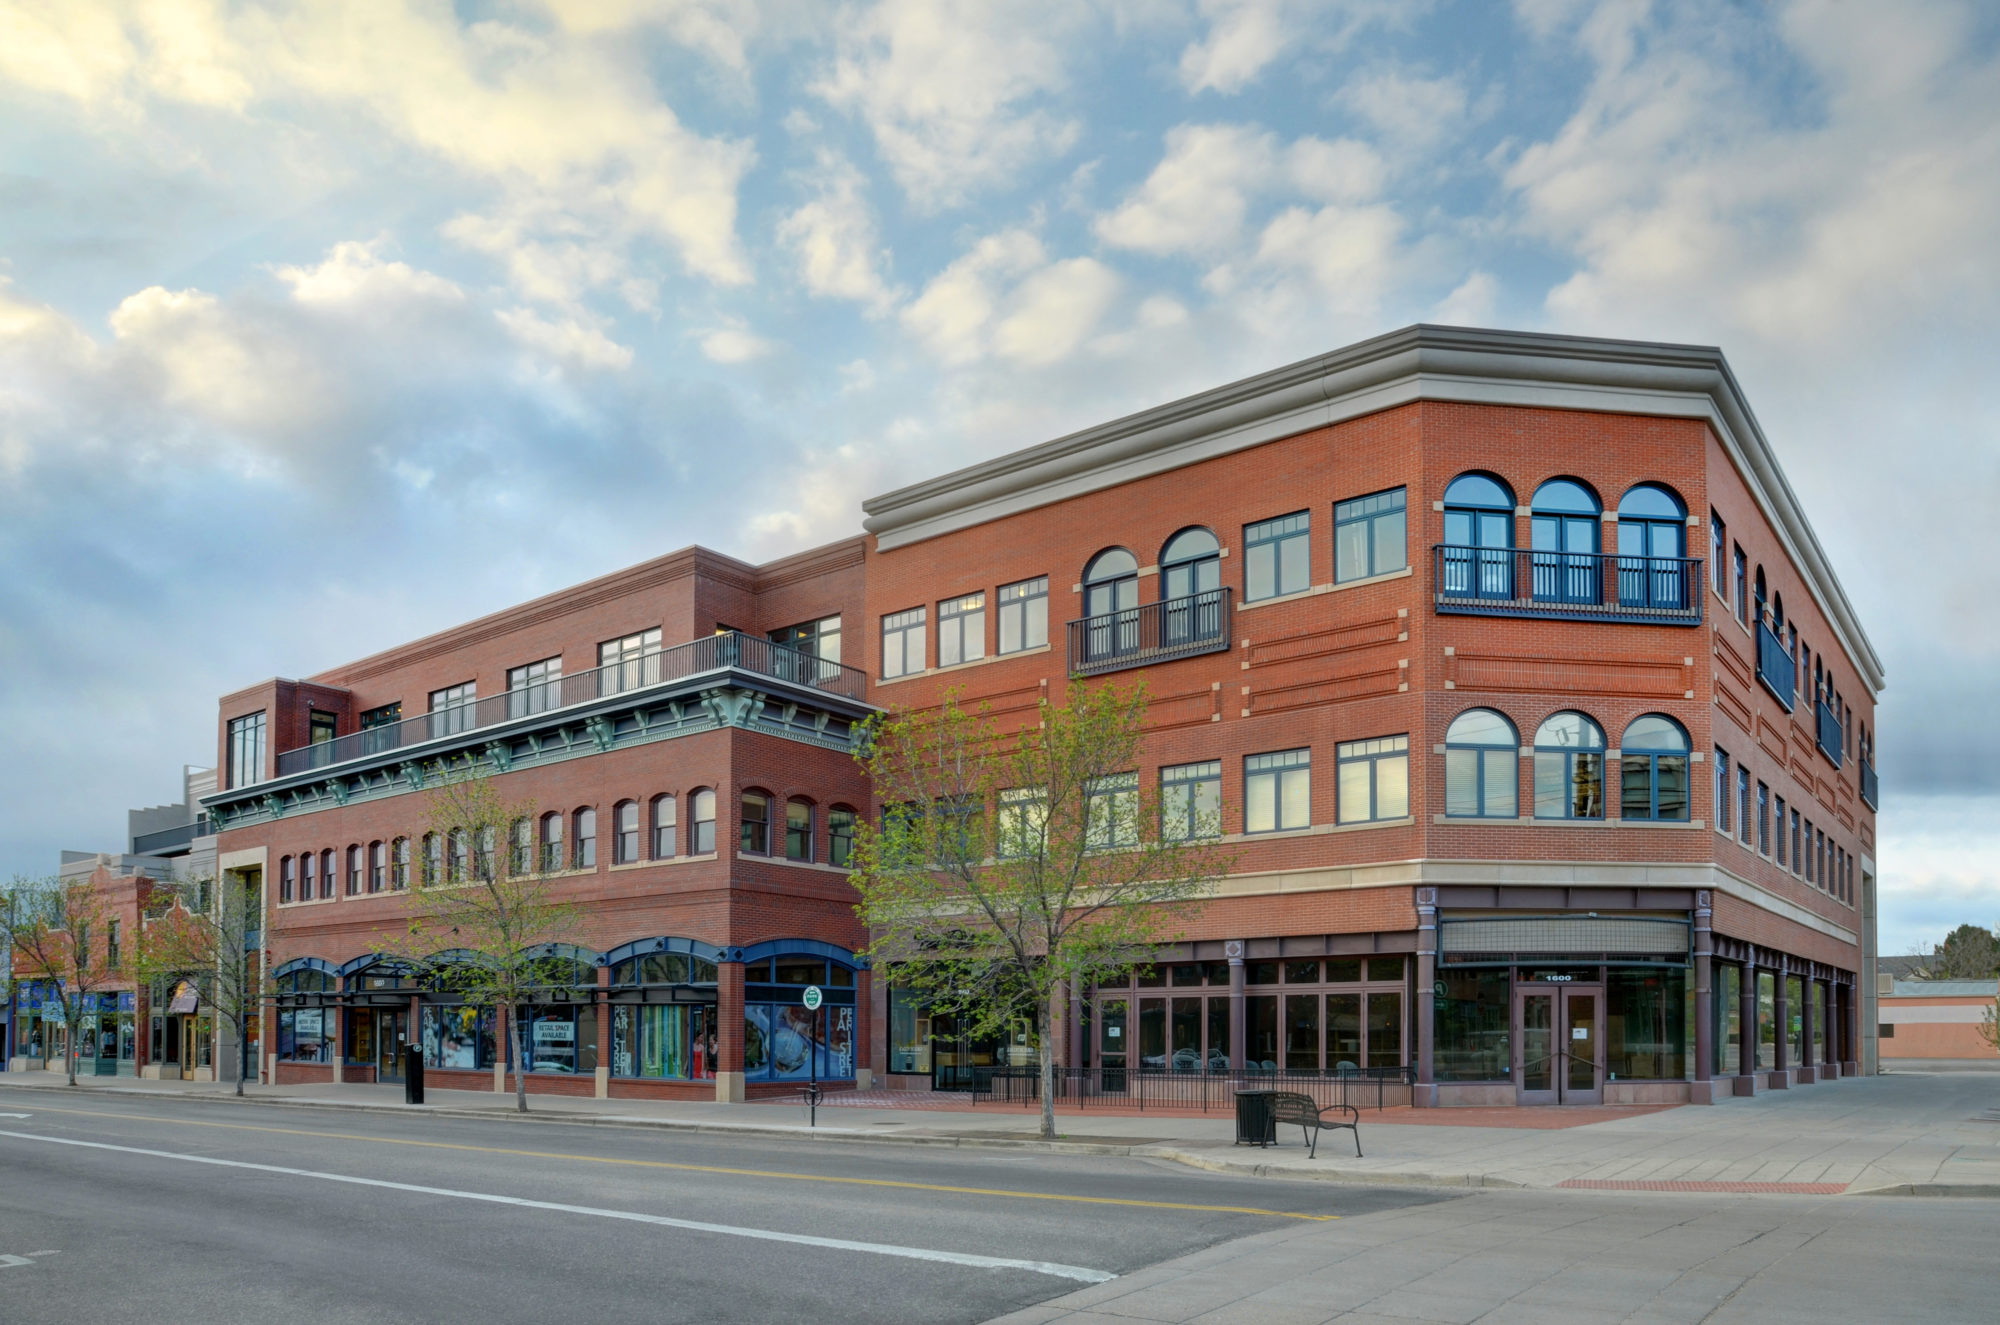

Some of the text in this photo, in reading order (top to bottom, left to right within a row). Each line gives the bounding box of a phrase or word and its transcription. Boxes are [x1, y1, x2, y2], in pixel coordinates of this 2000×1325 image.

[614, 1005, 627, 1017] PE
[840, 1007, 853, 1020] PE
[614, 1017, 628, 1029] AR
[836, 1019, 853, 1031] AR
[614, 1040, 626, 1052] ST
